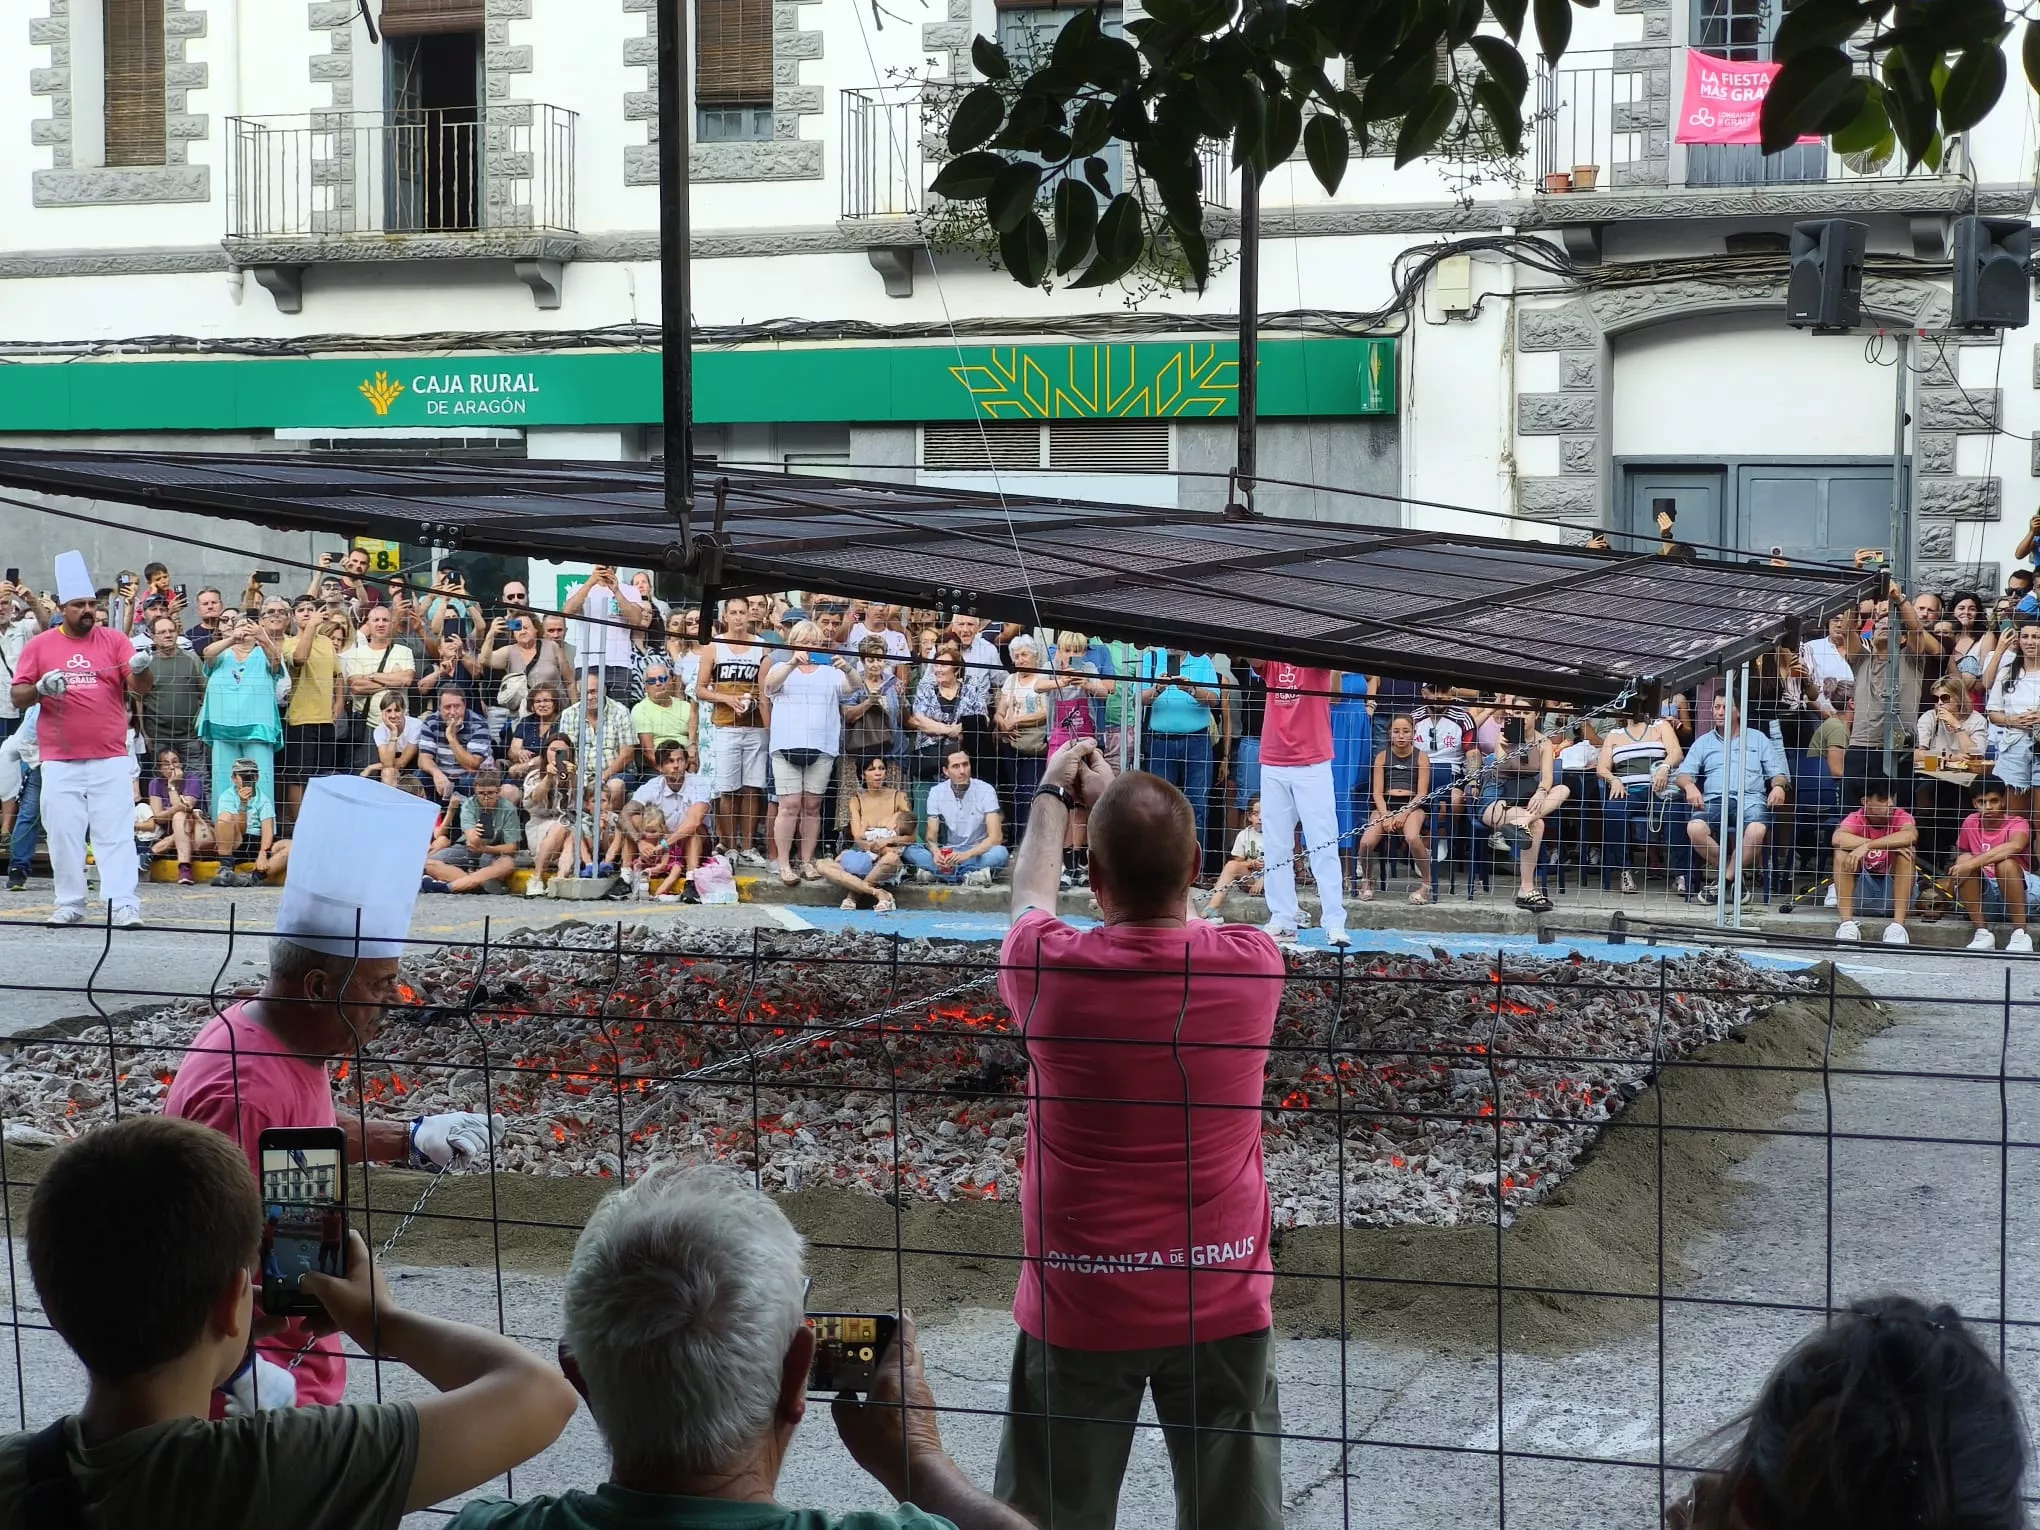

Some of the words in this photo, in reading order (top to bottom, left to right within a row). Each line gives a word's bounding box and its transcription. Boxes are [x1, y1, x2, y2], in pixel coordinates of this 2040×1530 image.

[1701, 69, 1719, 85] LA
[1721, 72, 1770, 86] FIESTA
[1700, 83, 1727, 98] MÁS
[1731, 88, 1769, 101] GRA
[412, 375, 464, 394] CAJA
[470, 372, 540, 393] RURAL
[427, 401, 449, 414] DE
[453, 396, 526, 414] ARAGÓN
[1044, 1250, 1164, 1274] ONGANIZA
[1170, 1249, 1185, 1264] DE
[1191, 1235, 1255, 1266] GRAUS
